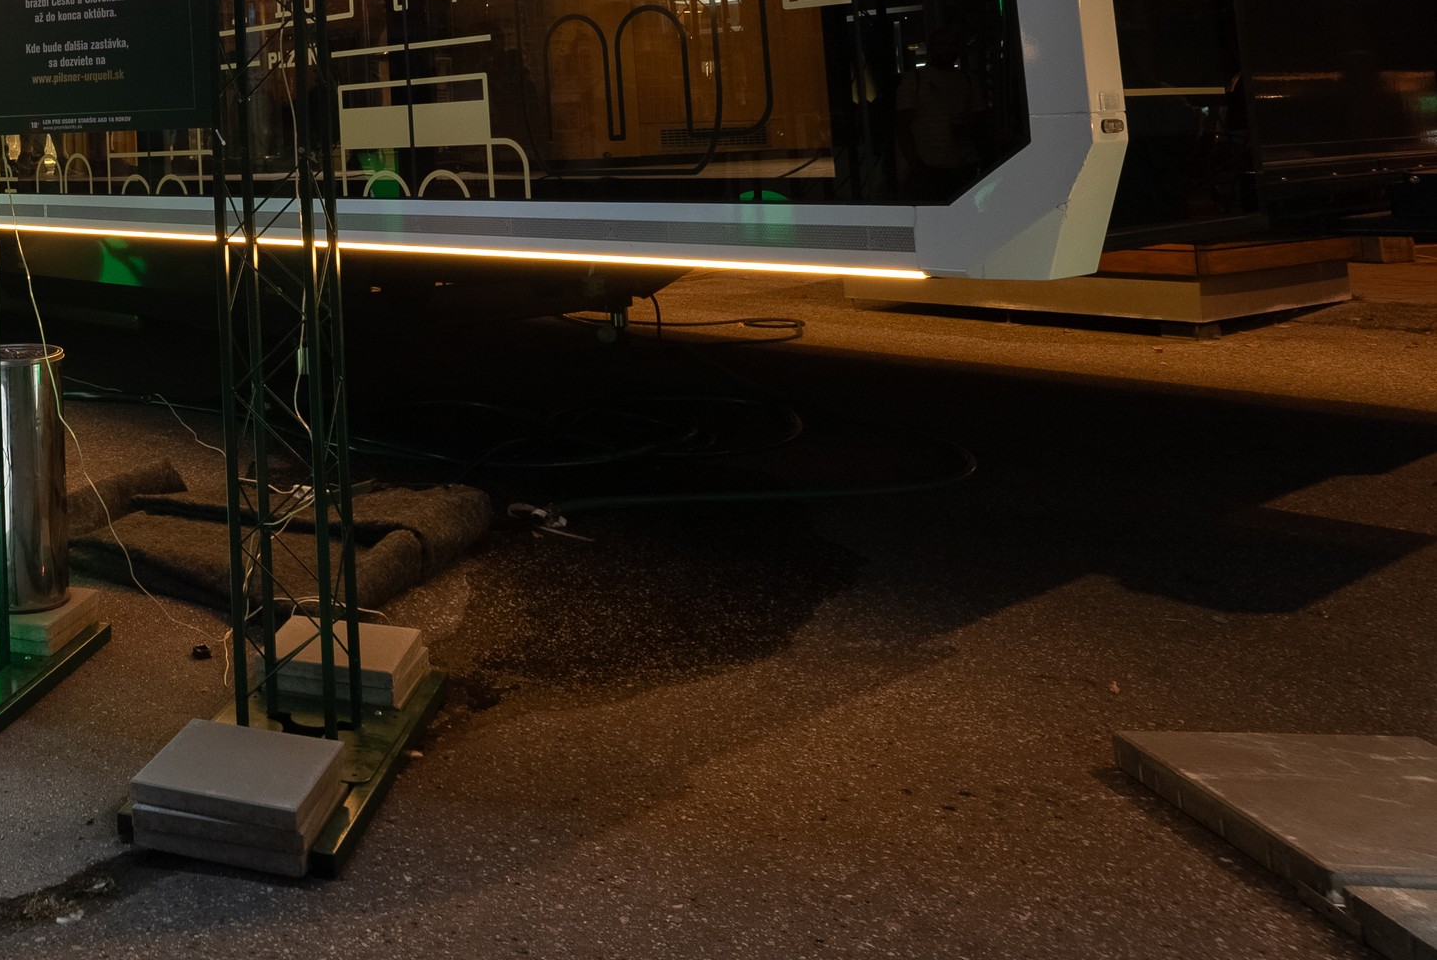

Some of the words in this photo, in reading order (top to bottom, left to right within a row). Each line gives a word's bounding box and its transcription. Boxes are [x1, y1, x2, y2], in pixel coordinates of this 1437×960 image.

[34, 12, 43, 23] až
[46, 12, 56, 22] do
[58, 10, 81, 21] konca
[84, 8, 117, 19] októbra.
[26, 43, 40, 54] Kde
[43, 42, 62, 52] bude
[64, 40, 88, 51] ďalšia
[90, 37, 129, 50] zastávka,
[48, 59, 58, 68] sa
[60, 56, 93, 67] dozviete
[96, 56, 106, 65] na
[268, 43, 318, 70] PLZŇ
[32, 69, 124, 85] www.pilsner-urquell.sk
